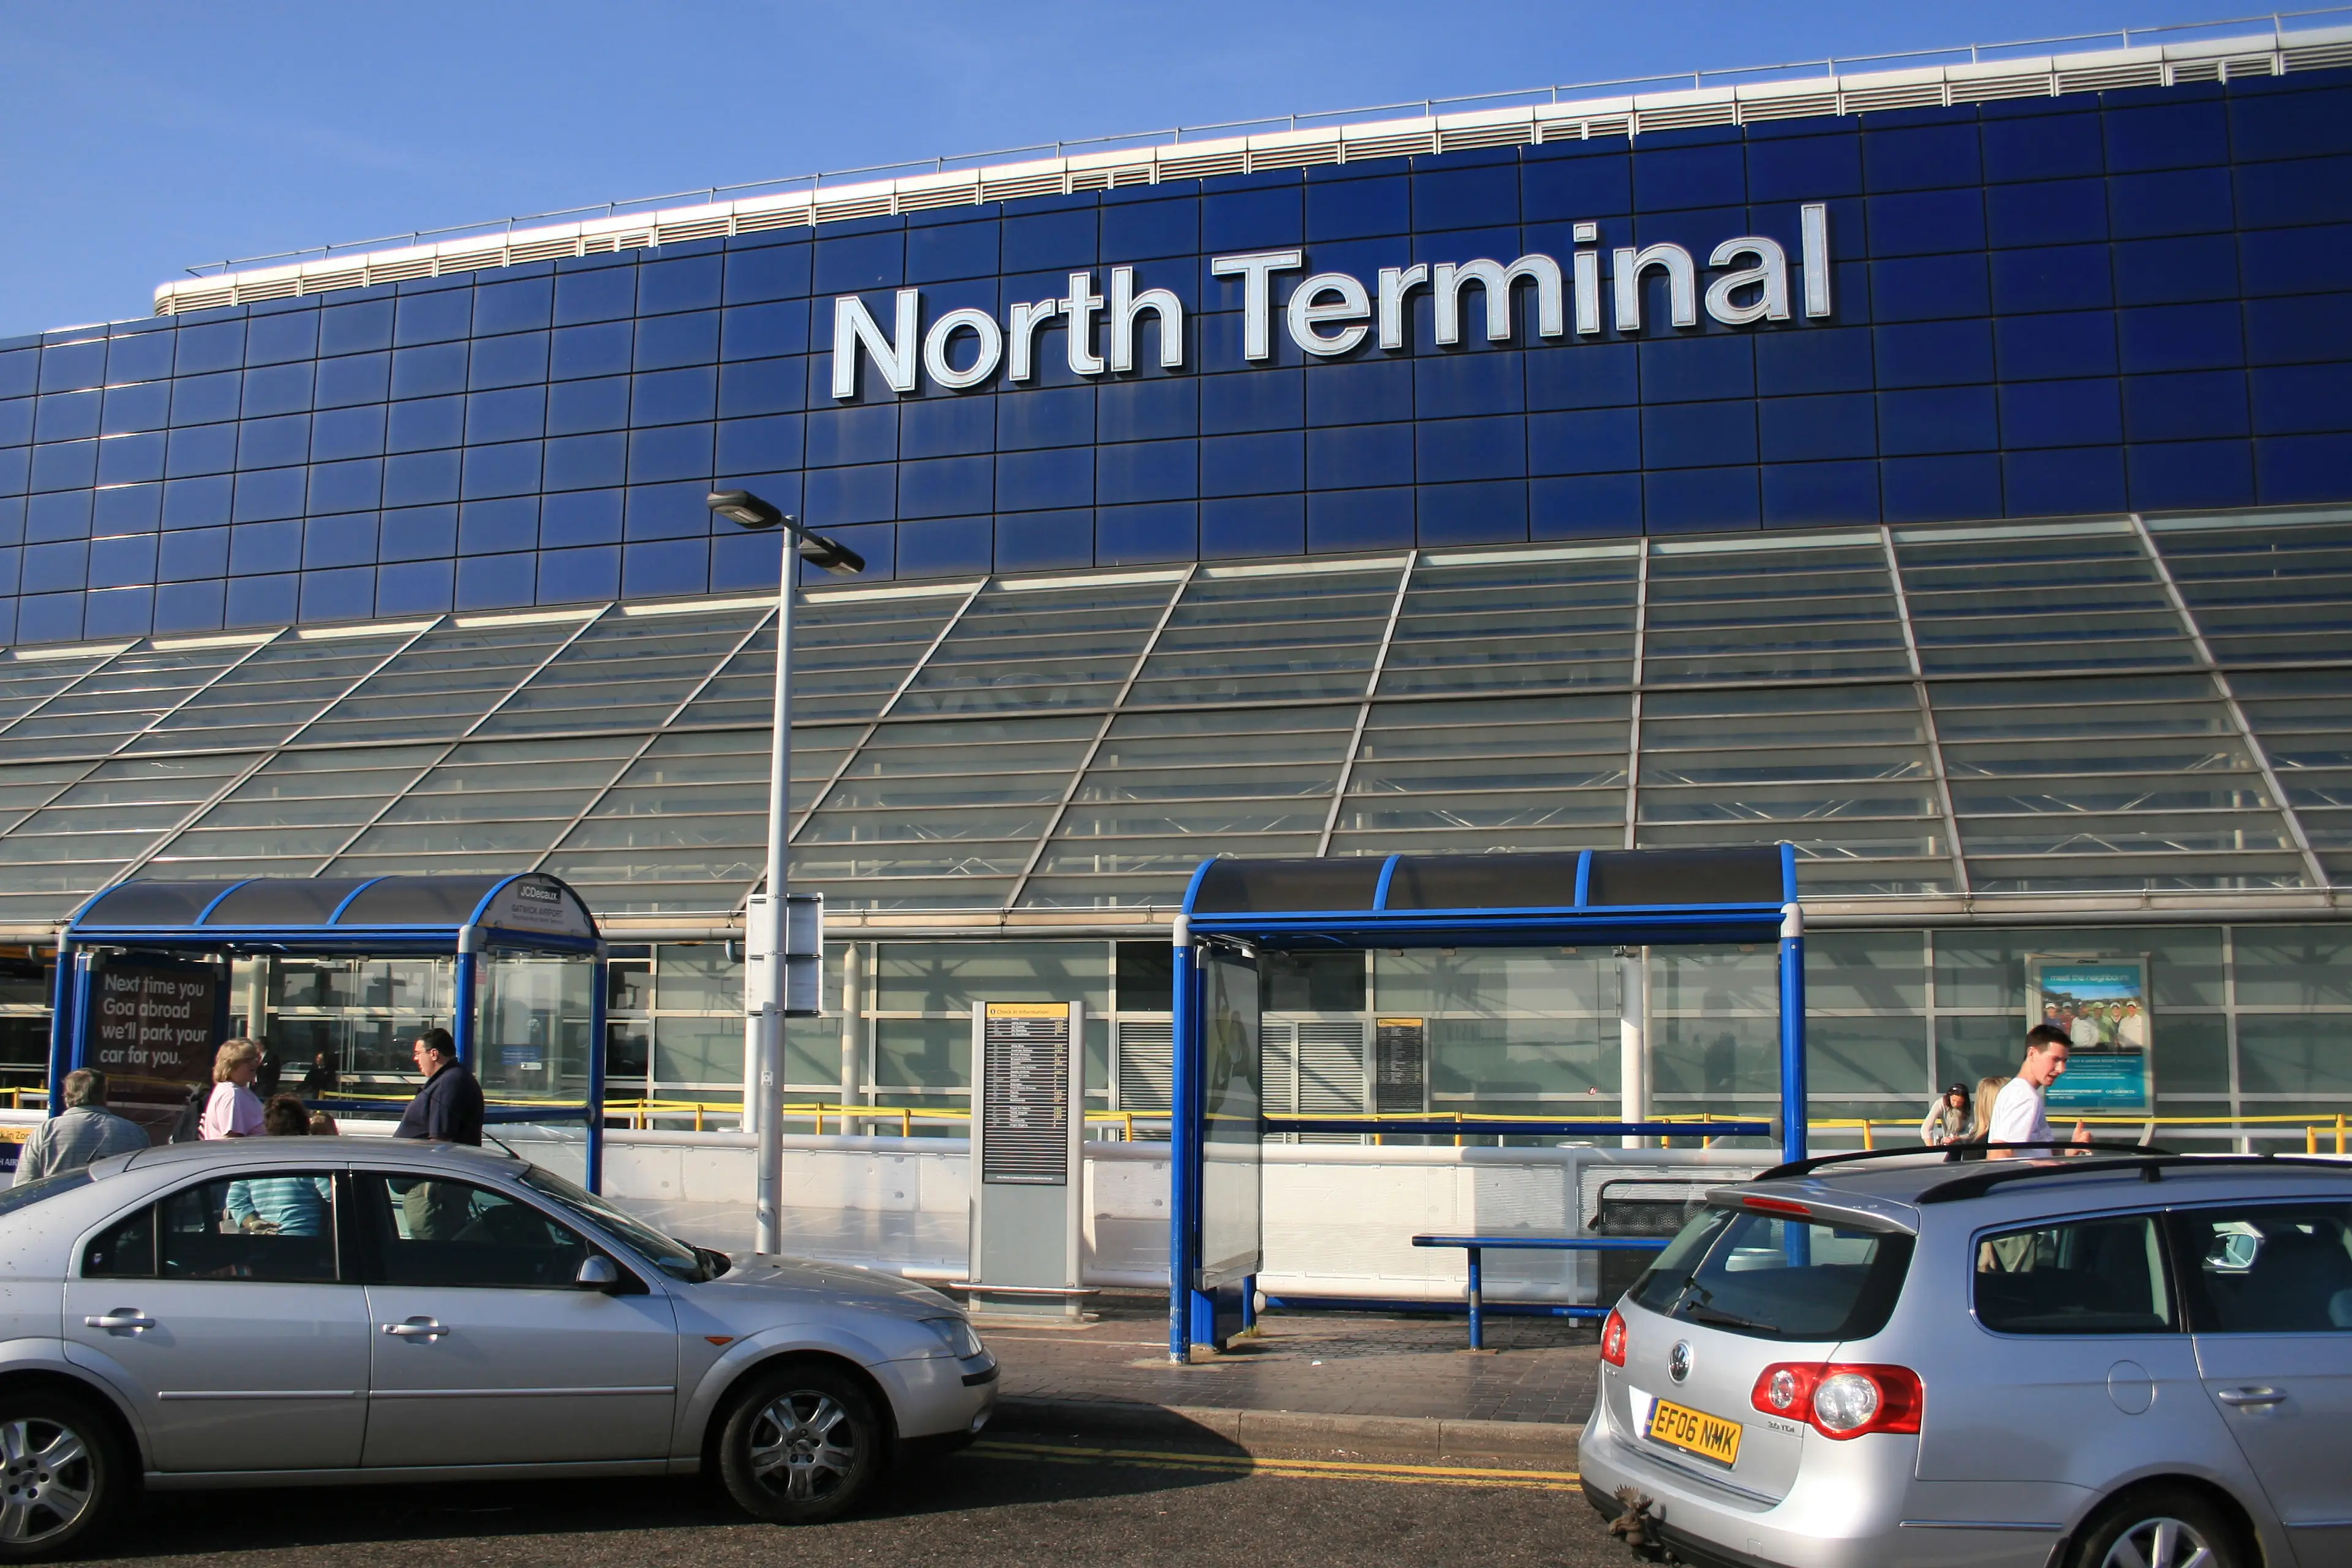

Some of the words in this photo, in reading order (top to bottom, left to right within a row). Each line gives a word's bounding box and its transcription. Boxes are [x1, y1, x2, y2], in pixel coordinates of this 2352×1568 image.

[830, 265, 1185, 401] North
[1210, 202, 1832, 362] Terminal
[521, 886, 557, 900] JCDecaux
[511, 904, 537, 914] GATWICK
[538, 908, 564, 918] AIRPORT
[105, 973, 140, 992] Next
[143, 976, 176, 995] time
[179, 982, 205, 1000] you
[103, 997, 135, 1016] Goa
[138, 999, 191, 1019] abroad
[140, 1023, 173, 1045] park
[176, 1028, 208, 1046] your
[99, 1049, 125, 1064] car
[127, 1045, 149, 1065] for
[152, 1050, 182, 1068] you.
[1655, 1405, 1698, 1442] EF06
[1699, 1419, 1736, 1456] NMK
